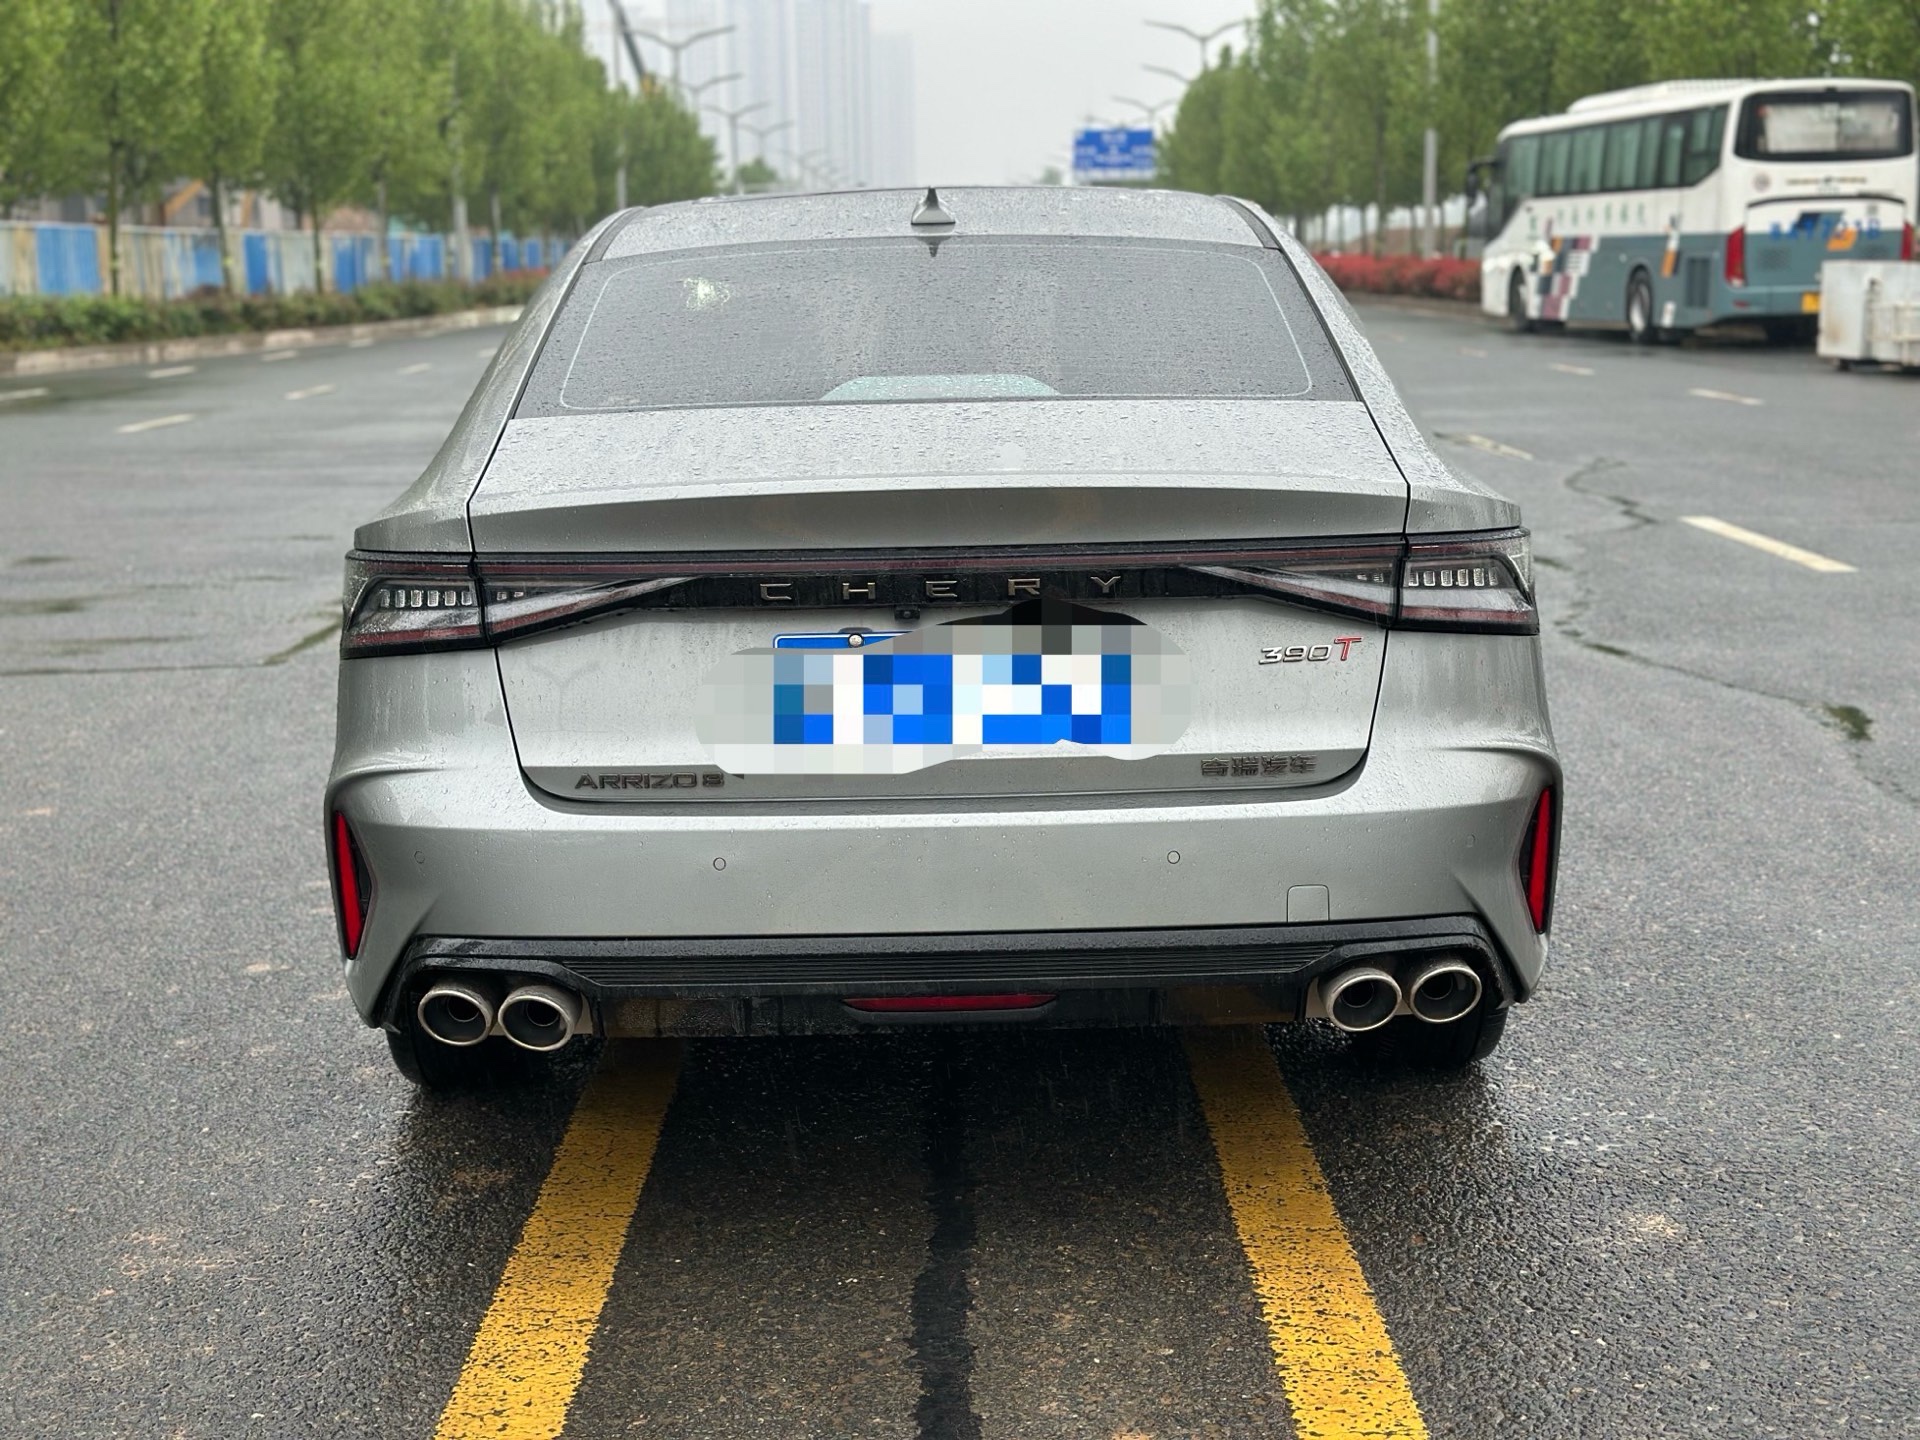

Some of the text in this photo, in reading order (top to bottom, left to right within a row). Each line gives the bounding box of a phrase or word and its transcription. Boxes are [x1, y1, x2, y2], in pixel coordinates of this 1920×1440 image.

[759, 575, 1121, 600] CHERY
[1258, 636, 1363, 665] 390T
[1200, 754, 1317, 777] 奇瑞汽车
[574, 771, 725, 790] ARRIZO 8
